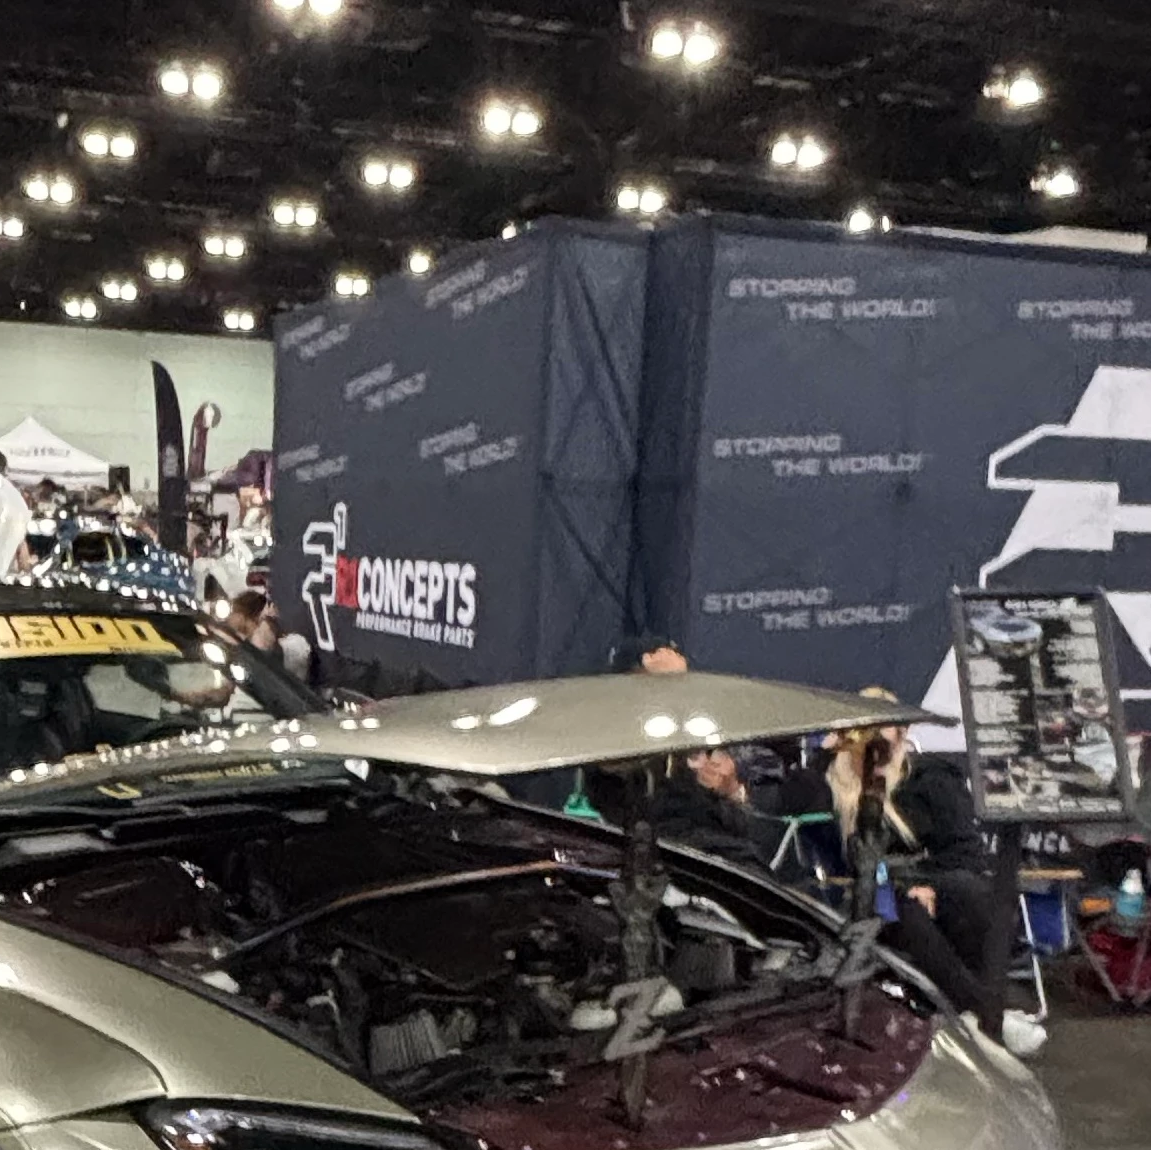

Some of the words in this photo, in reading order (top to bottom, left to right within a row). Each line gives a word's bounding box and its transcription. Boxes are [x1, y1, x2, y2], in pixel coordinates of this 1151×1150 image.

[785, 301, 833, 320] THE
[1070, 322, 1113, 340] THE
[772, 459, 820, 477] THE
[762, 611, 809, 631] THE
